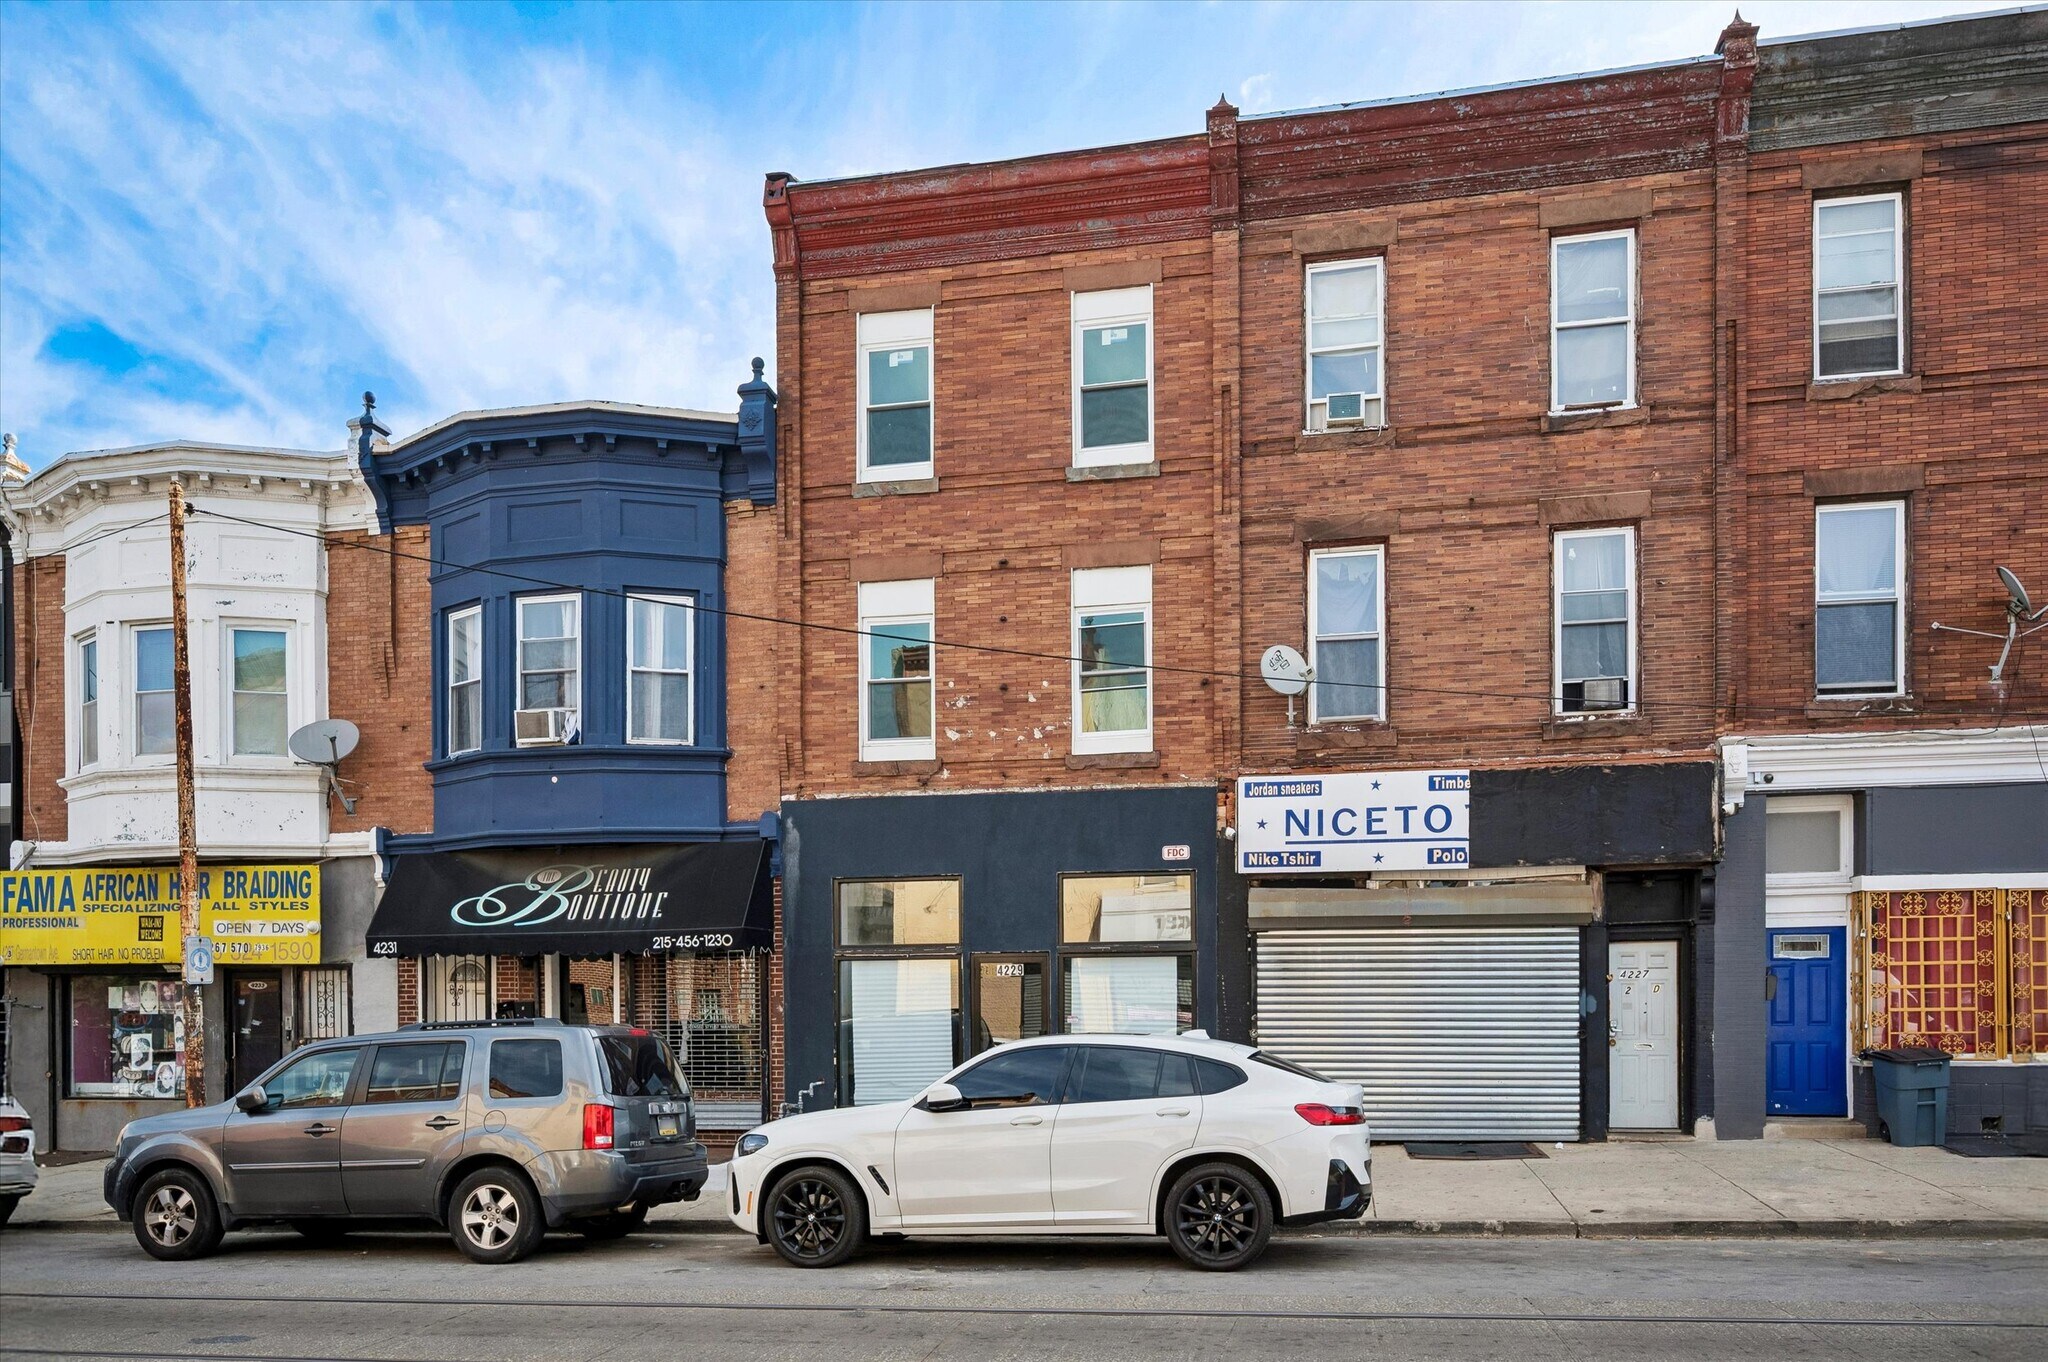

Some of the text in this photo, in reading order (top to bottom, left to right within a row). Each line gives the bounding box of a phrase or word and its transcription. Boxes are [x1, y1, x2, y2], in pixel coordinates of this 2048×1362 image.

[1249, 782, 1320, 797] Jordan sneakers
[1285, 804, 1453, 837] NICETO
[1167, 848, 1185, 857] FDC
[1248, 851, 1316, 866] Nike Tshir
[1433, 848, 1465, 863] Polo
[2, 870, 312, 913] FAMA AFRICAN HR BRAIDING
[83, 903, 181, 913] SPECIALIZING
[211, 901, 240, 911] ALL
[249, 901, 310, 911] STYLES
[2, 917, 79, 928] PROFESSIONAL
[216, 922, 305, 934] OPEN 7 DAYS
[231, 942, 249, 953] 570
[373, 941, 398, 954] 4231
[652, 934, 733, 949] 215-456-1230
[72, 948, 165, 960] SHORT HAIR NO PROBLEM
[271, 942, 313, 960] 1590
[998, 965, 1023, 975] 4229
[1620, 970, 1649, 978] 4227
